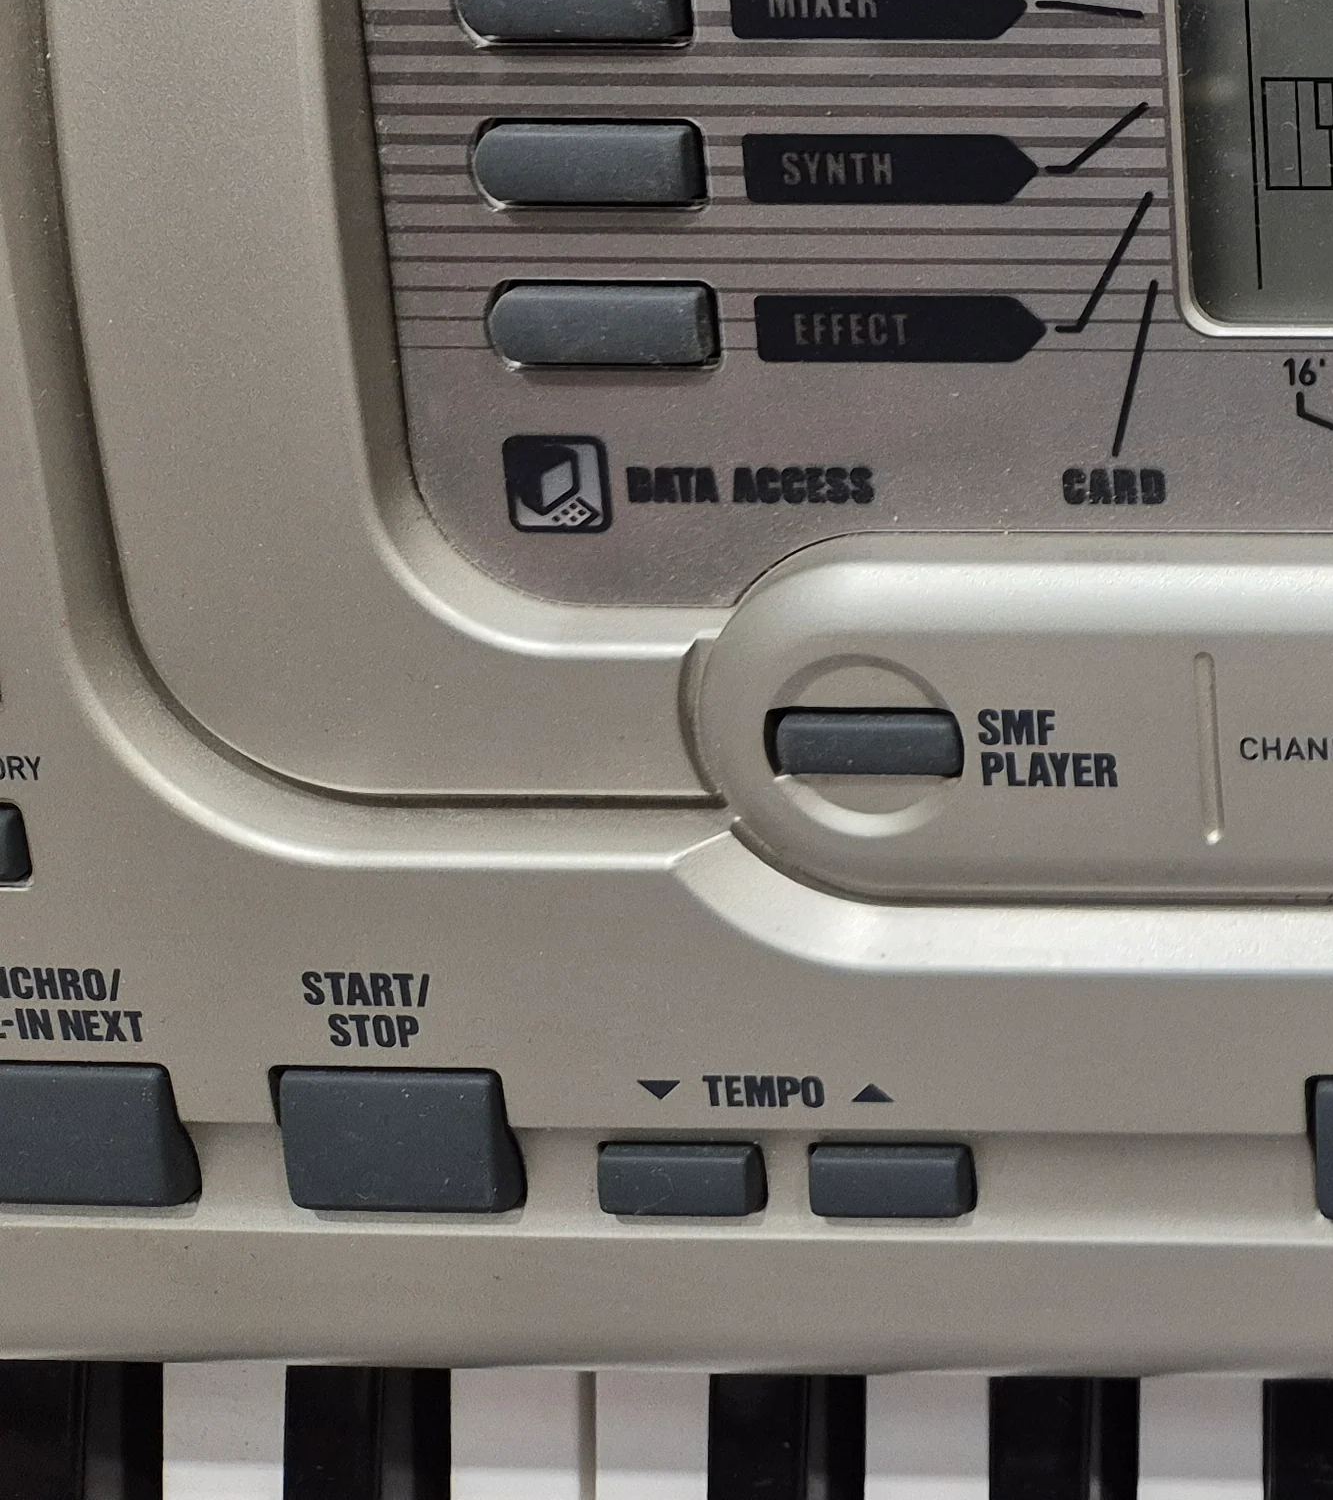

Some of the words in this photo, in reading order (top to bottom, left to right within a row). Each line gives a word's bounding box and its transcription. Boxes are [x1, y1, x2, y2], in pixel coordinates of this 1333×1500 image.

[782, 152, 893, 184] SYNTH
[794, 313, 907, 345] EFFECT
[1283, 357, 1326, 387] 16'
[625, 466, 720, 504] DATA
[732, 466, 875, 505] ACCESS
[1061, 467, 1166, 506] CARD
[977, 708, 1055, 746] SMF
[980, 751, 1118, 788] PLAYER
[301, 971, 430, 1008] START/
[57, 1009, 143, 1043] NEXT
[327, 1013, 420, 1048] STOP
[701, 1075, 825, 1109] TEMPO
